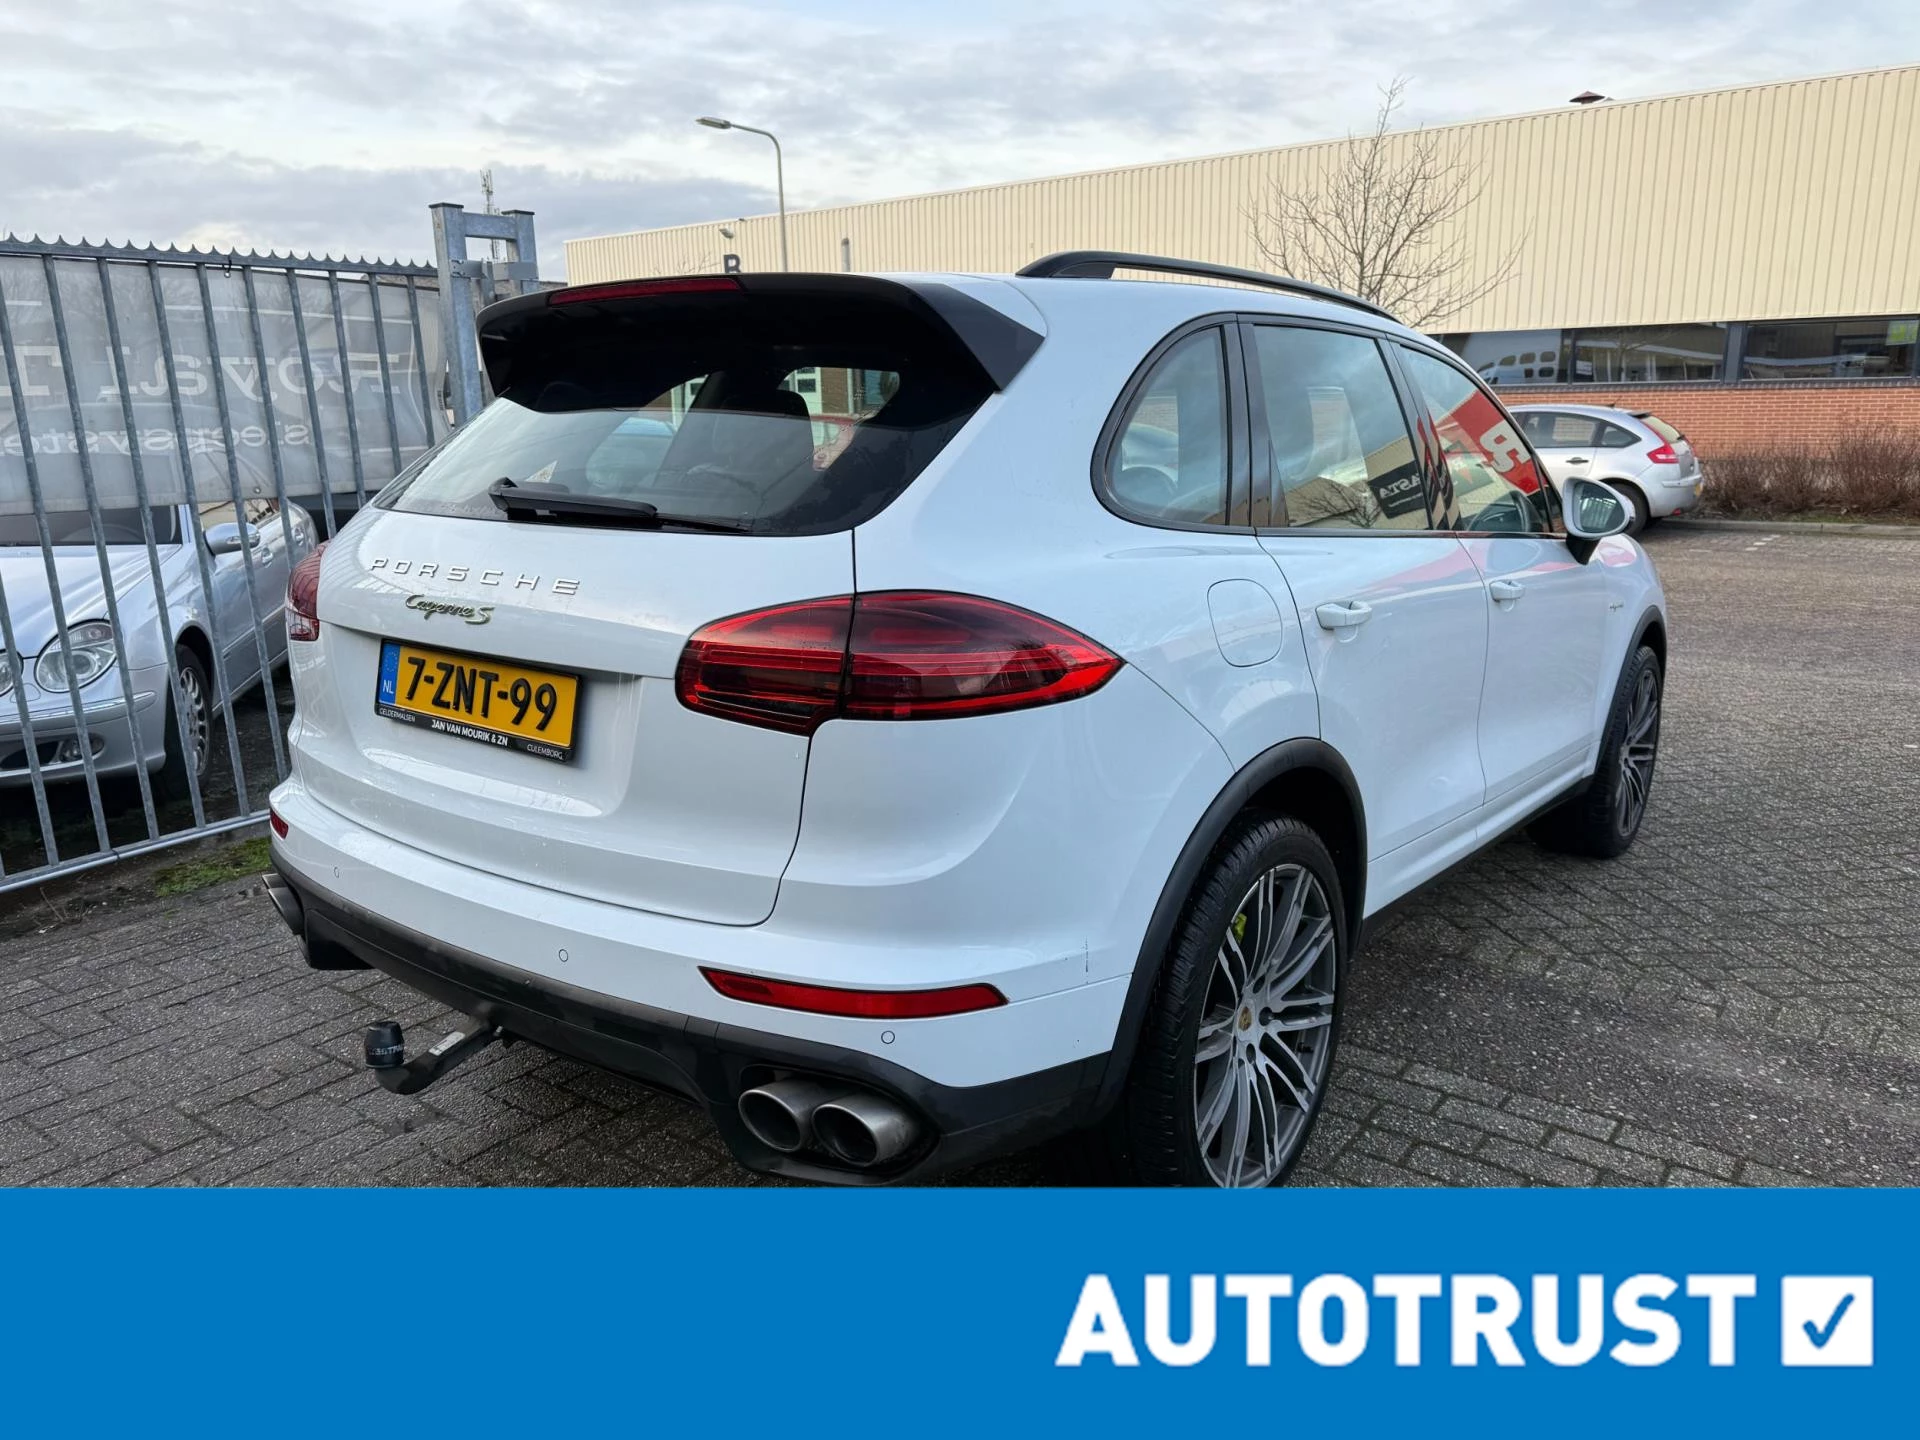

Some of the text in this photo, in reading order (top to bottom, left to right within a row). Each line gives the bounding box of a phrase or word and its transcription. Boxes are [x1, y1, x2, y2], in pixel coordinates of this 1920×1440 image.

[370, 558, 581, 595] PORSCHE
[405, 594, 496, 625] Cayenne S
[382, 679, 395, 695] NL
[404, 656, 558, 732] 7-ZNT-99
[431, 719, 508, 746] JAN VAN MOURIK & ZN
[526, 743, 564, 760] CULEMBORG
